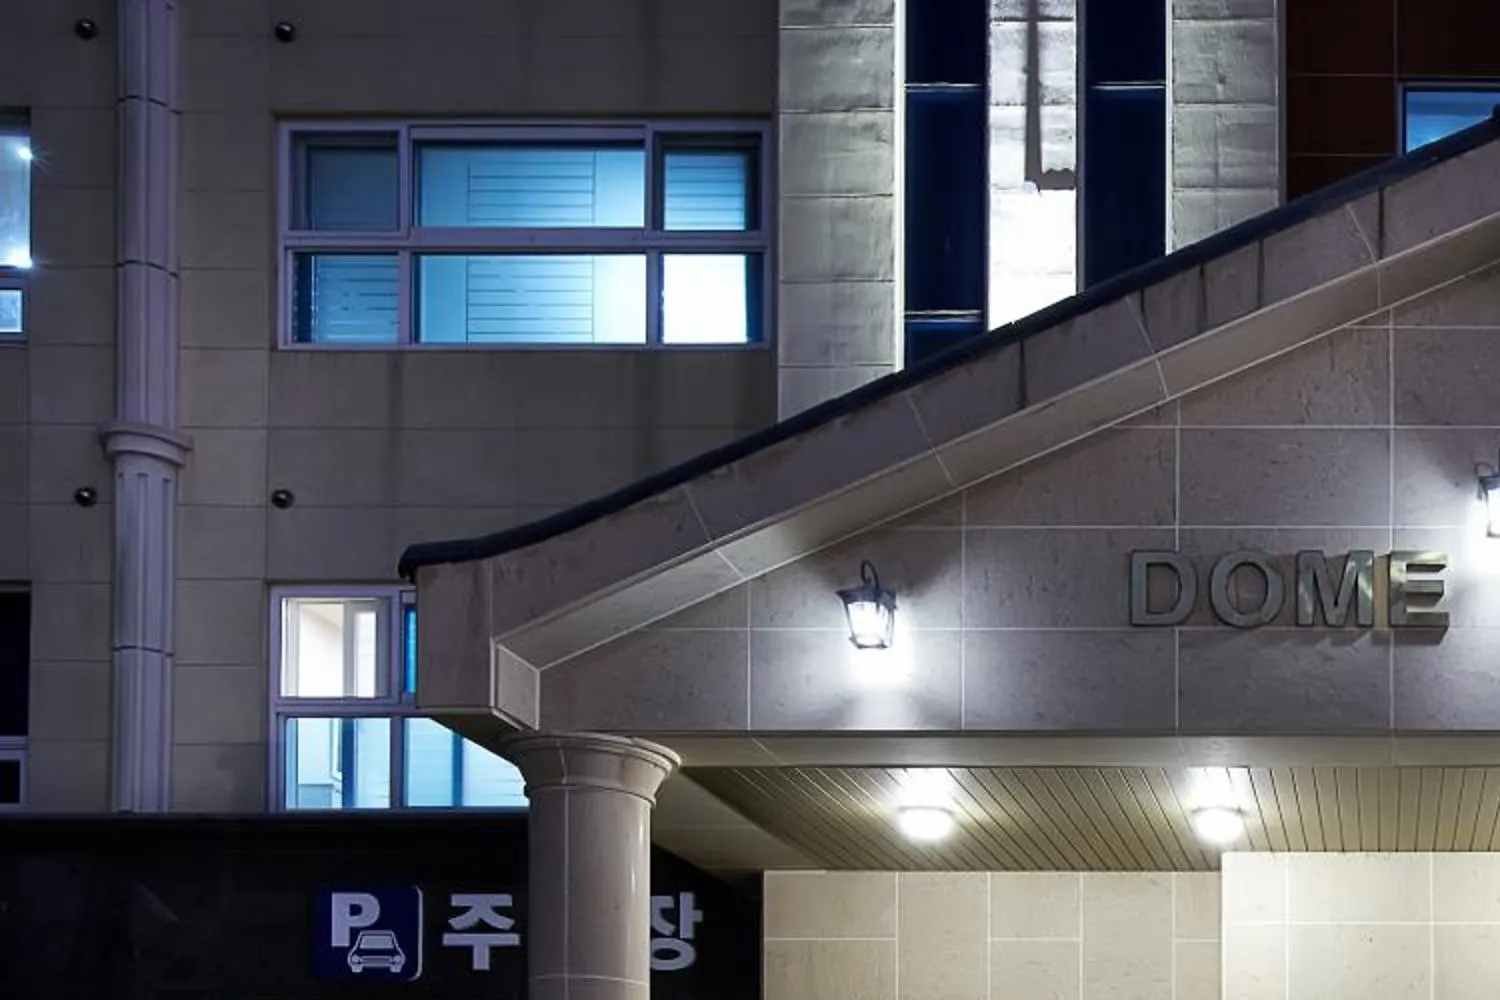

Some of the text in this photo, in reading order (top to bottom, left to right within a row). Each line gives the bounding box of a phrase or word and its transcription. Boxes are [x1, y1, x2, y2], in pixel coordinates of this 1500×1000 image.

[1128, 549, 1450, 627] DOME
[331, 892, 381, 948] P
[442, 892, 704, 972] 주장
